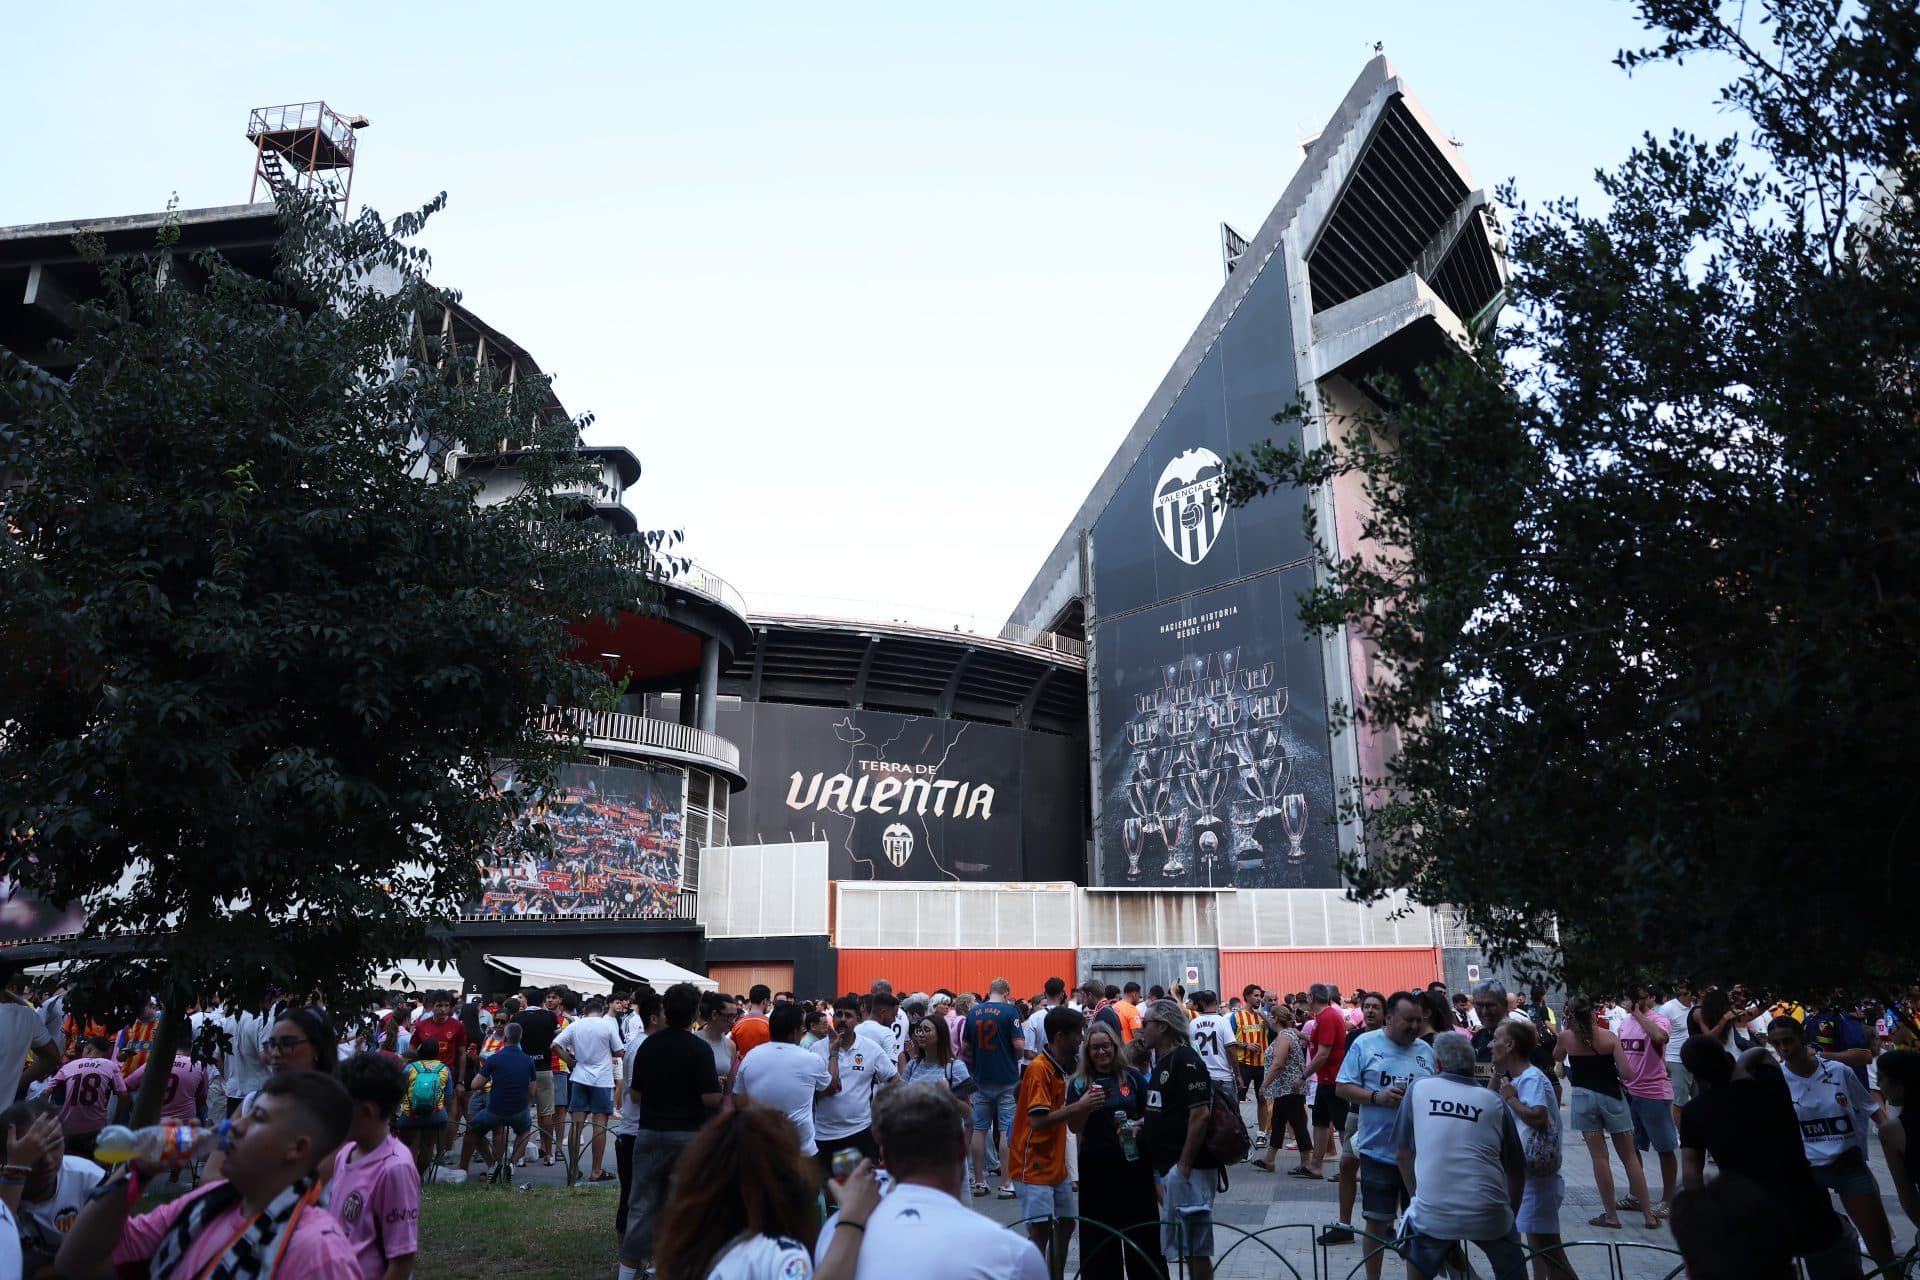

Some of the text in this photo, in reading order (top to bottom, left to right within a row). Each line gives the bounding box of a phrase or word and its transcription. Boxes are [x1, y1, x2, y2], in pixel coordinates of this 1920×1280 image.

[1160, 484, 1203, 504] VALENCIA
[1160, 606, 1238, 633] HACIENDO HISTORIA
[1177, 621, 1220, 639] DESDE 1919
[858, 760, 938, 776] TERRA DE
[976, 1020, 999, 1051] 12
[1195, 1031, 1219, 1056] 21
[70, 1073, 101, 1106] 18
[1429, 1099, 1483, 1122] TONY
